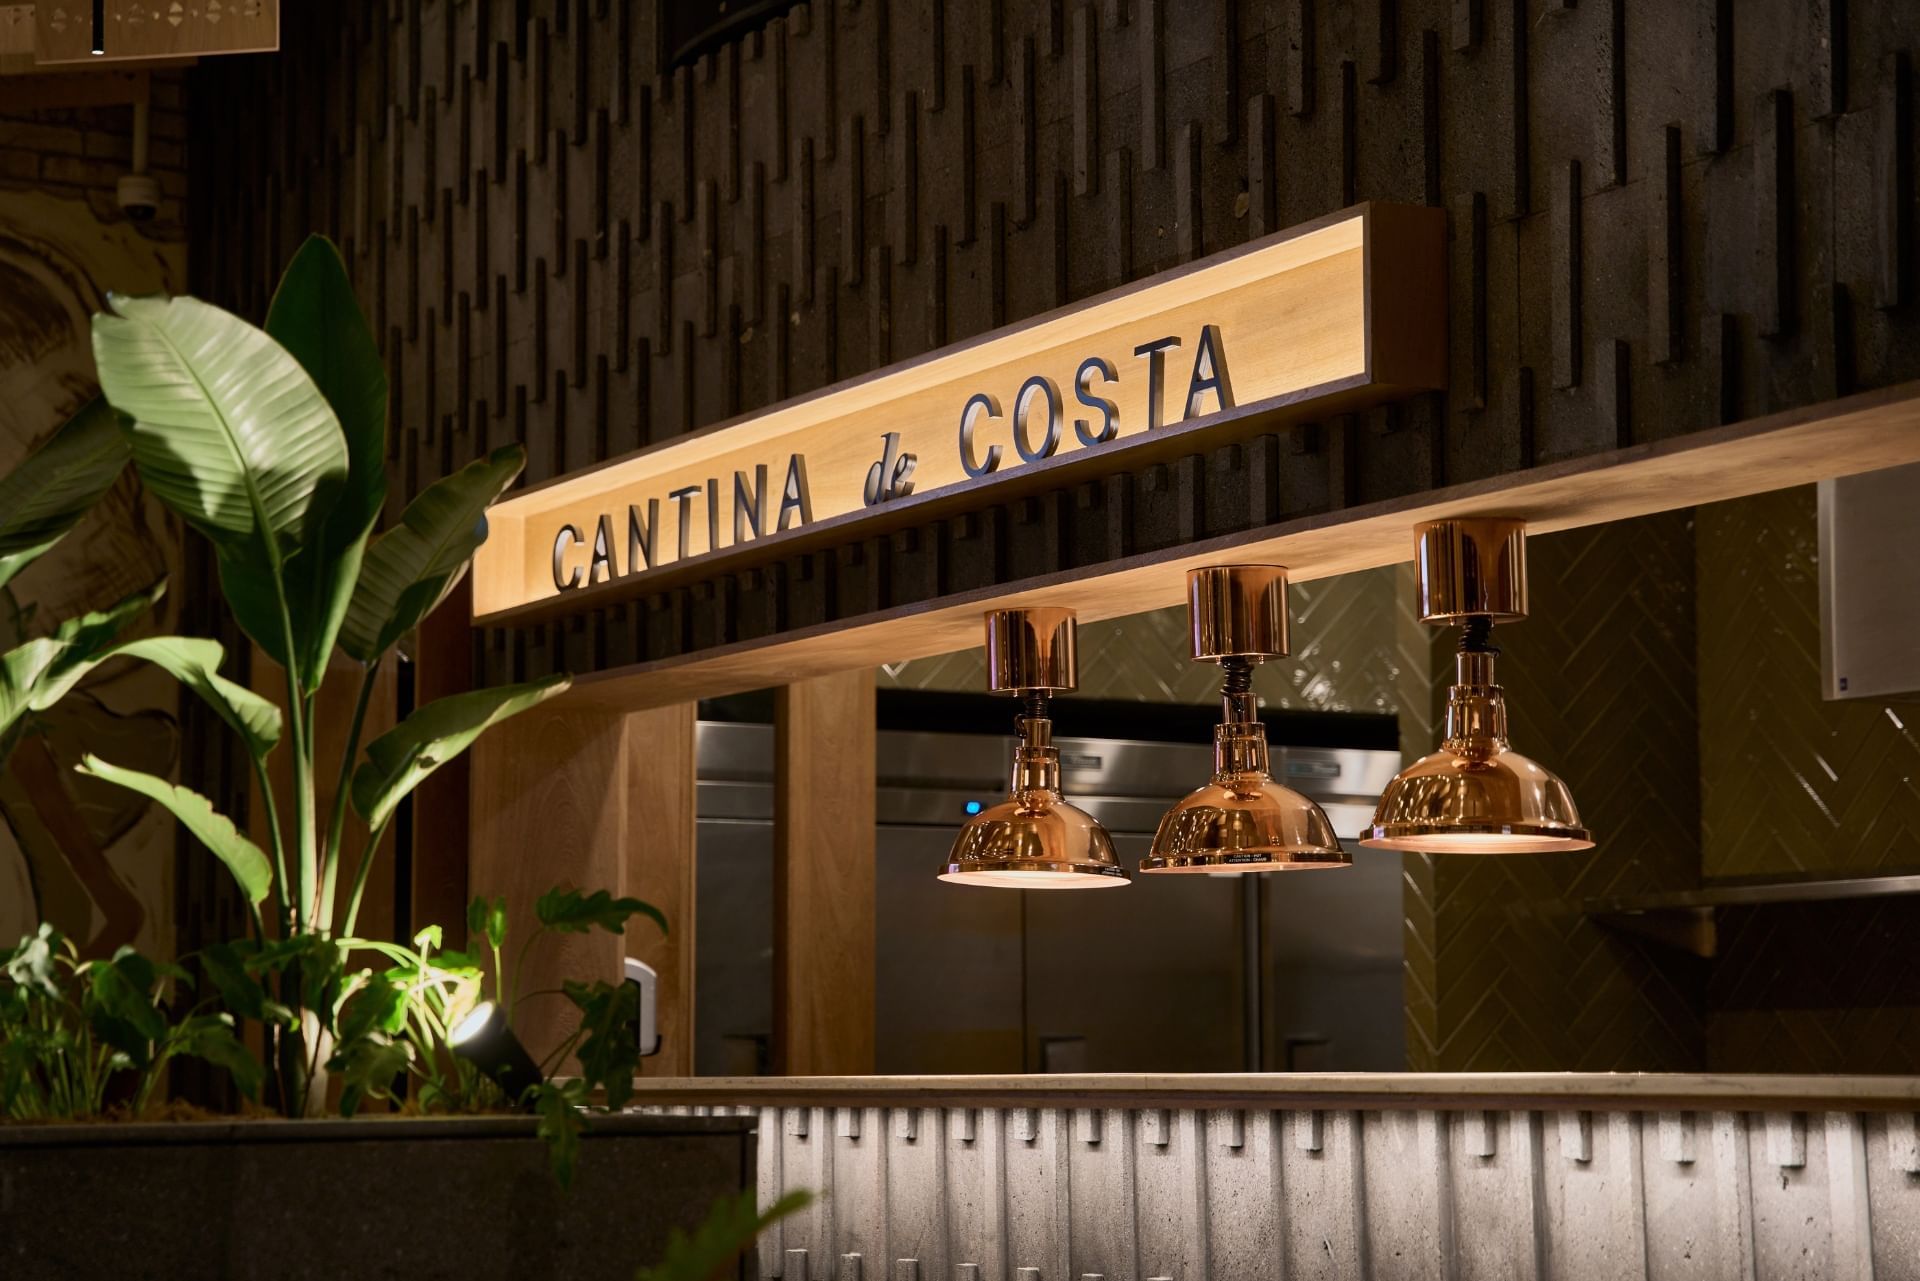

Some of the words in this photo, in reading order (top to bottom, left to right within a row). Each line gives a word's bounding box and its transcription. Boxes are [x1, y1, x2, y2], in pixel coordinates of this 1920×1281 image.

[553, 453, 813, 592] CANTINA
[863, 431, 918, 506] de
[959, 324, 1236, 478] COSTA
